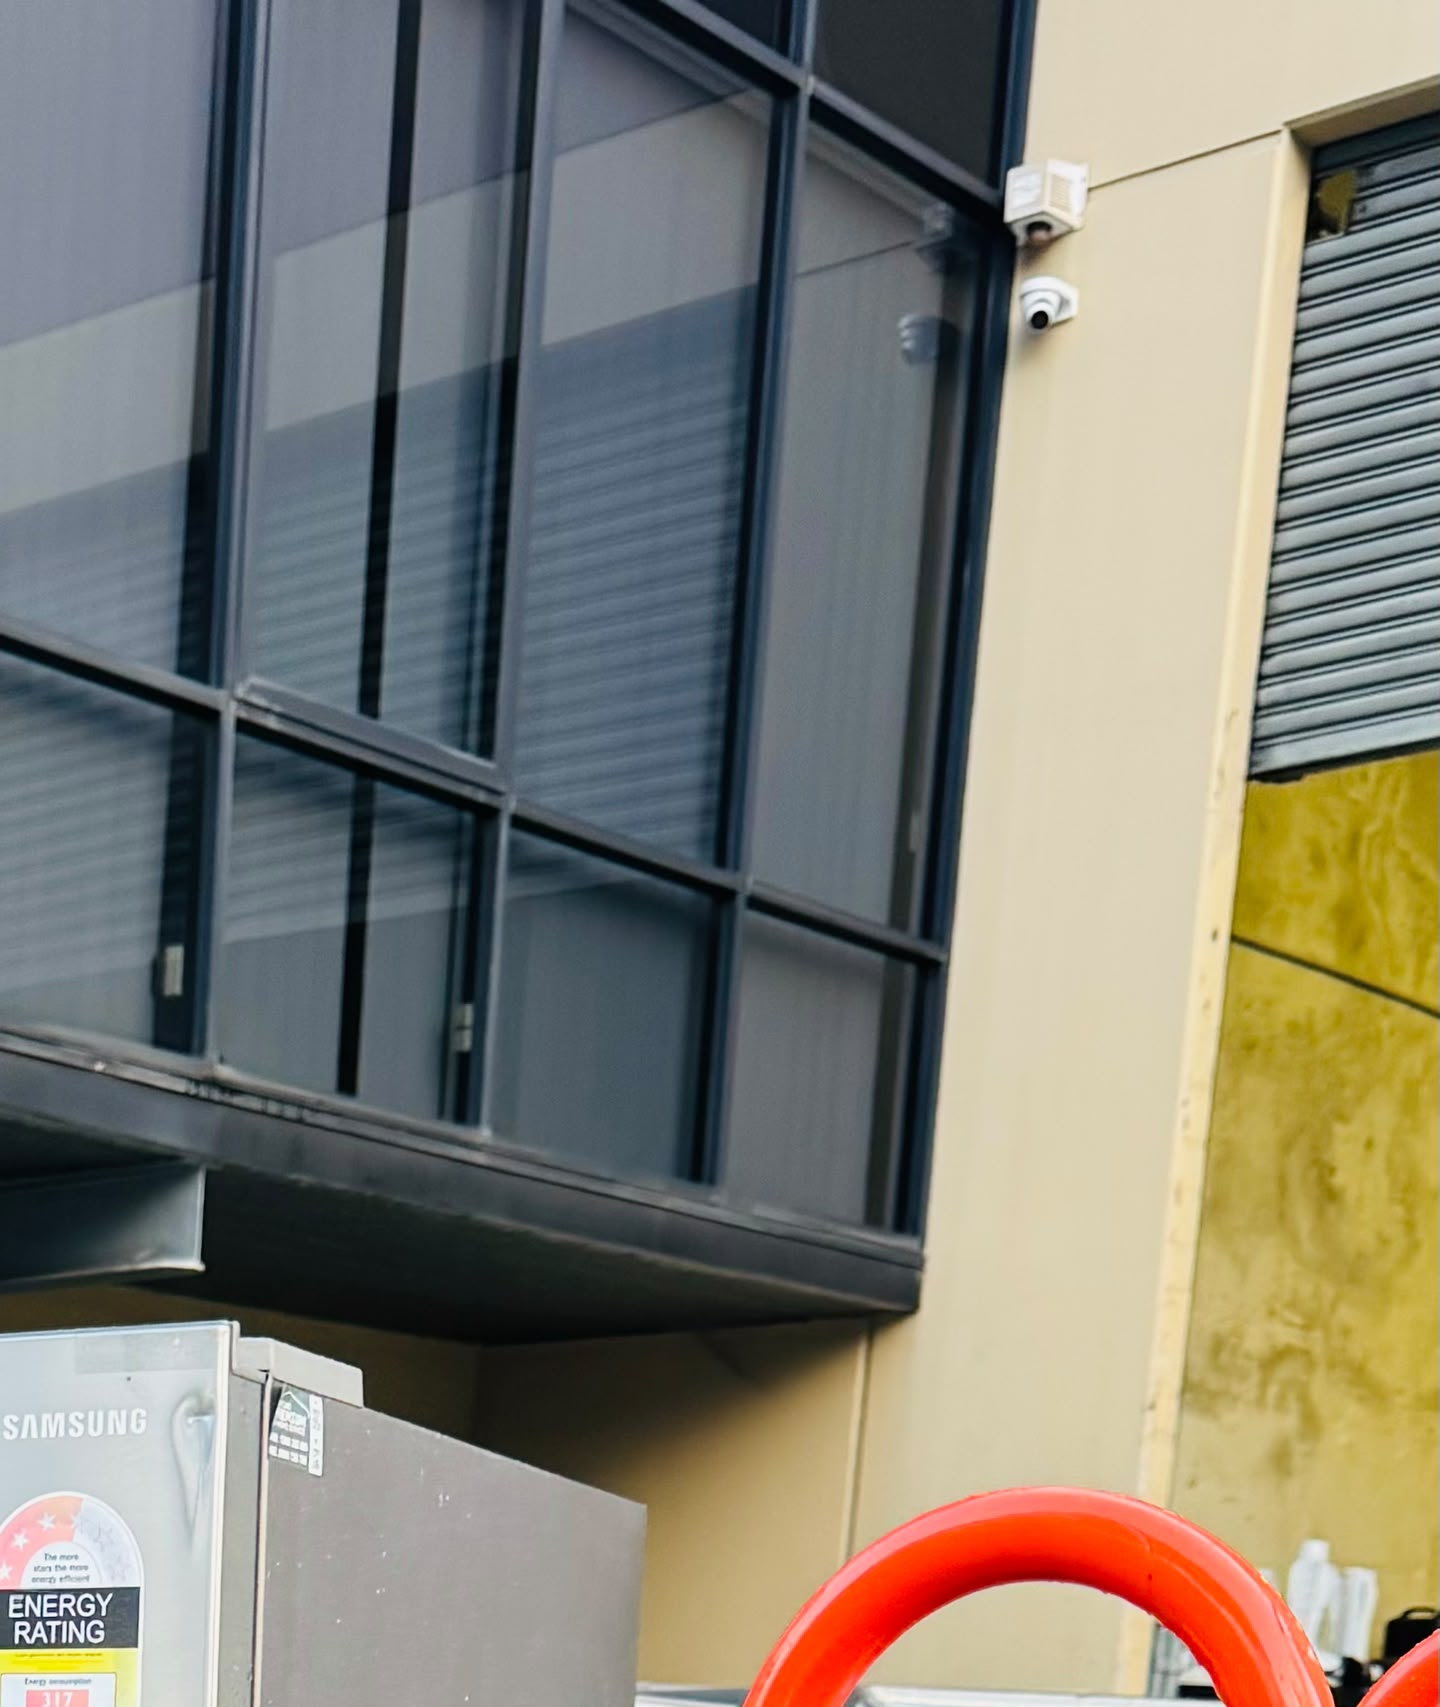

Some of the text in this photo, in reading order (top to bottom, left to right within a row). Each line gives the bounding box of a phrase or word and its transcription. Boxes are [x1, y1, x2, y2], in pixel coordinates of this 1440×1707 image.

[2, 1407, 148, 1441] SAMSUNG
[8, 1592, 113, 1618] ENERGY
[14, 1619, 105, 1645] RATING
